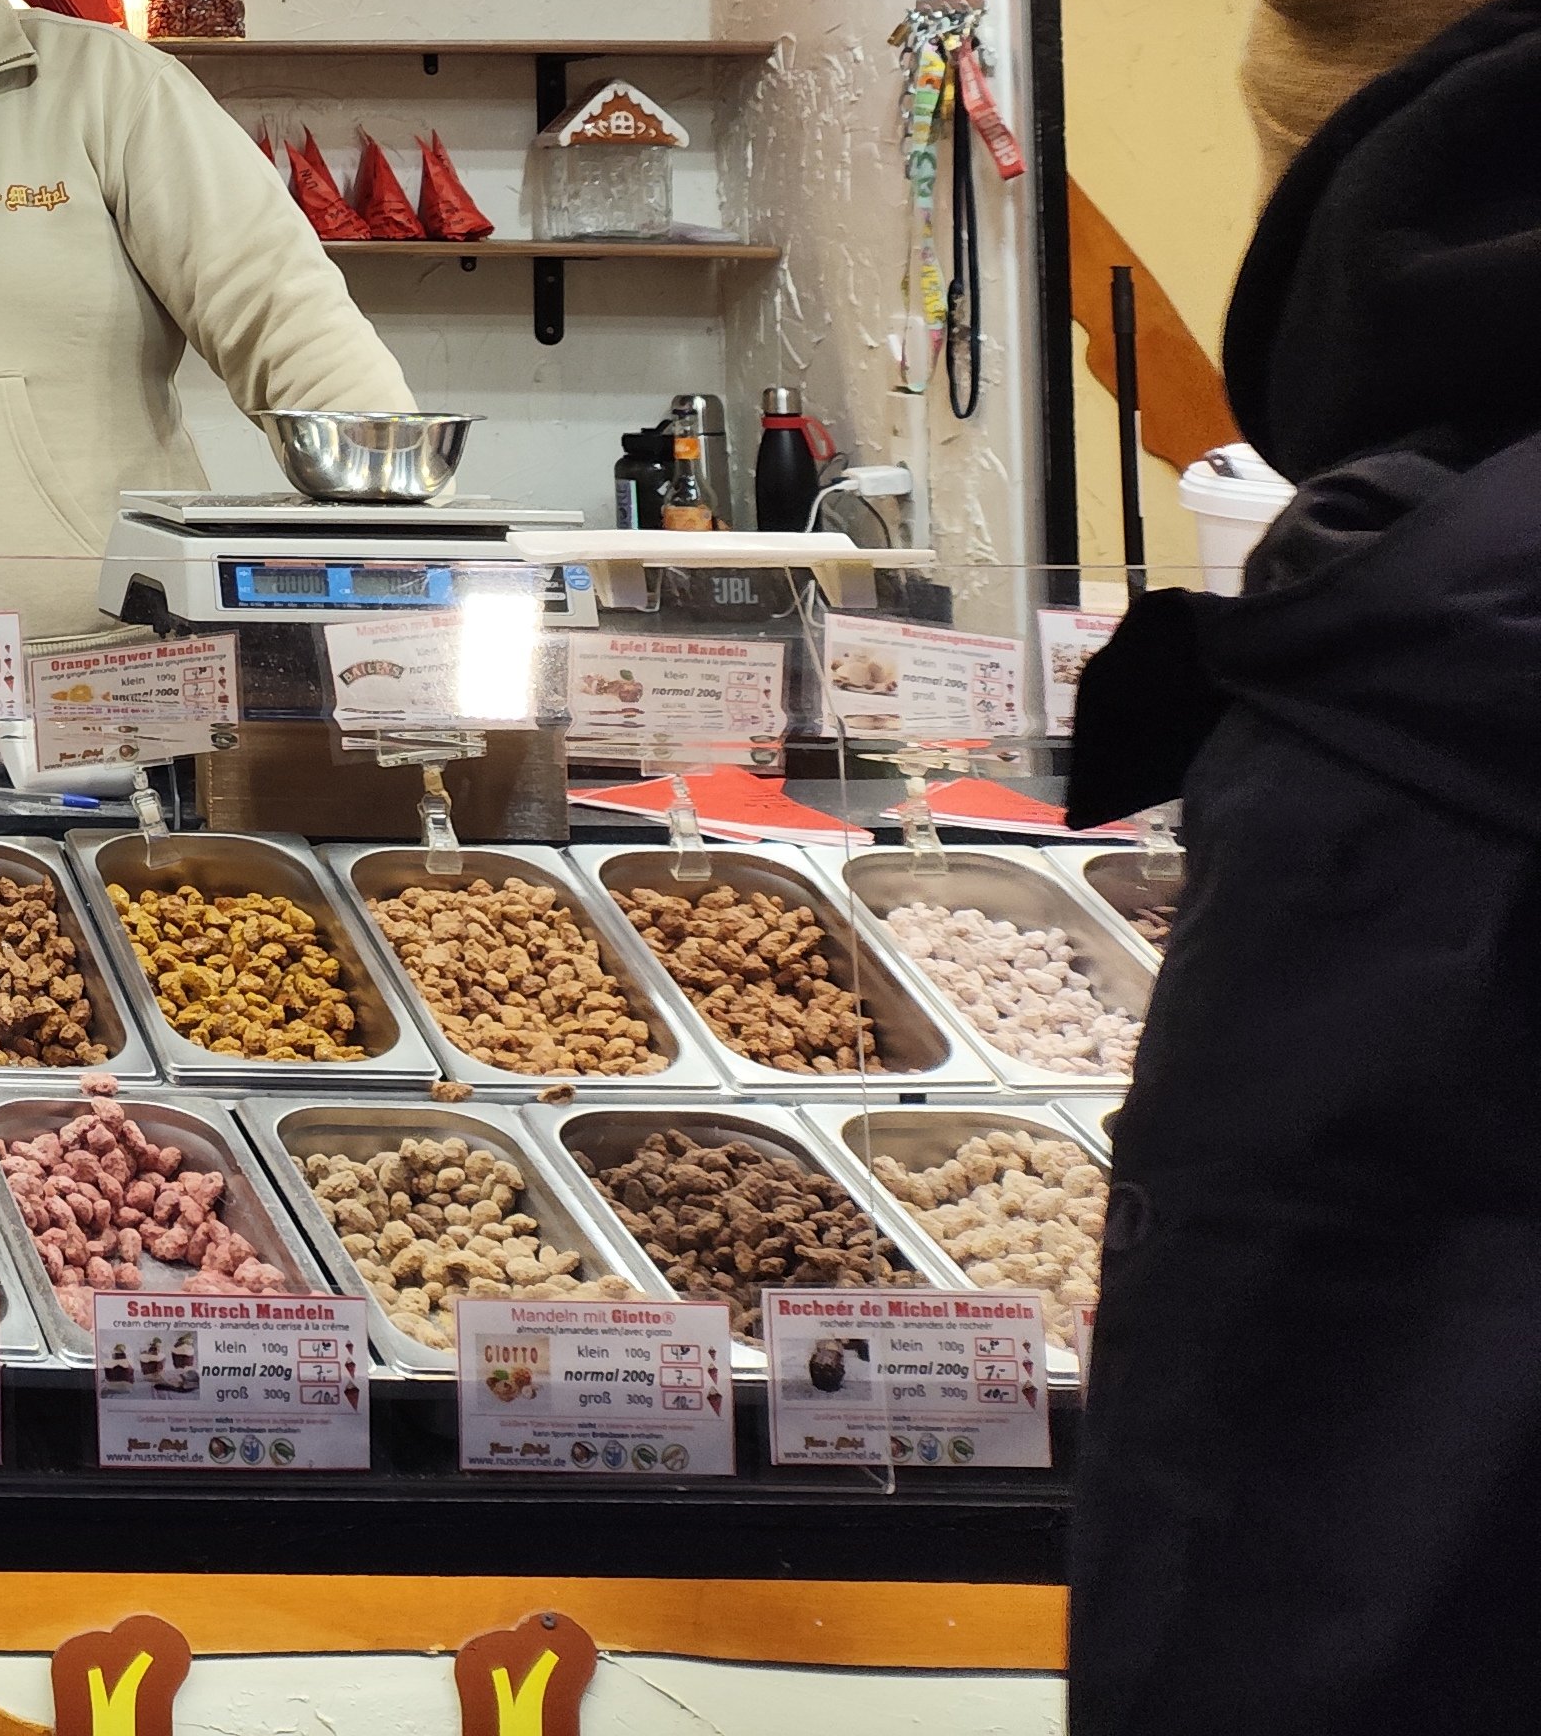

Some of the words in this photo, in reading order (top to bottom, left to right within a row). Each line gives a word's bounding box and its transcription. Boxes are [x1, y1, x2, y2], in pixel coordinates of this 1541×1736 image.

[713, 577, 758, 604] JBL
[51, 658, 100, 671] Orange
[342, 661, 403, 683] BAILEYS
[127, 1301, 185, 1318] Sahne
[191, 1302, 250, 1318] Kirsch
[256, 1304, 334, 1320] Mandeln
[512, 1309, 577, 1323] Mandeln
[584, 1310, 607, 1323] mit
[860, 1302, 881, 1316] de
[888, 1301, 949, 1318] Michel
[955, 1302, 1032, 1319] Mandeln
[485, 1345, 538, 1364] GIOTTO
